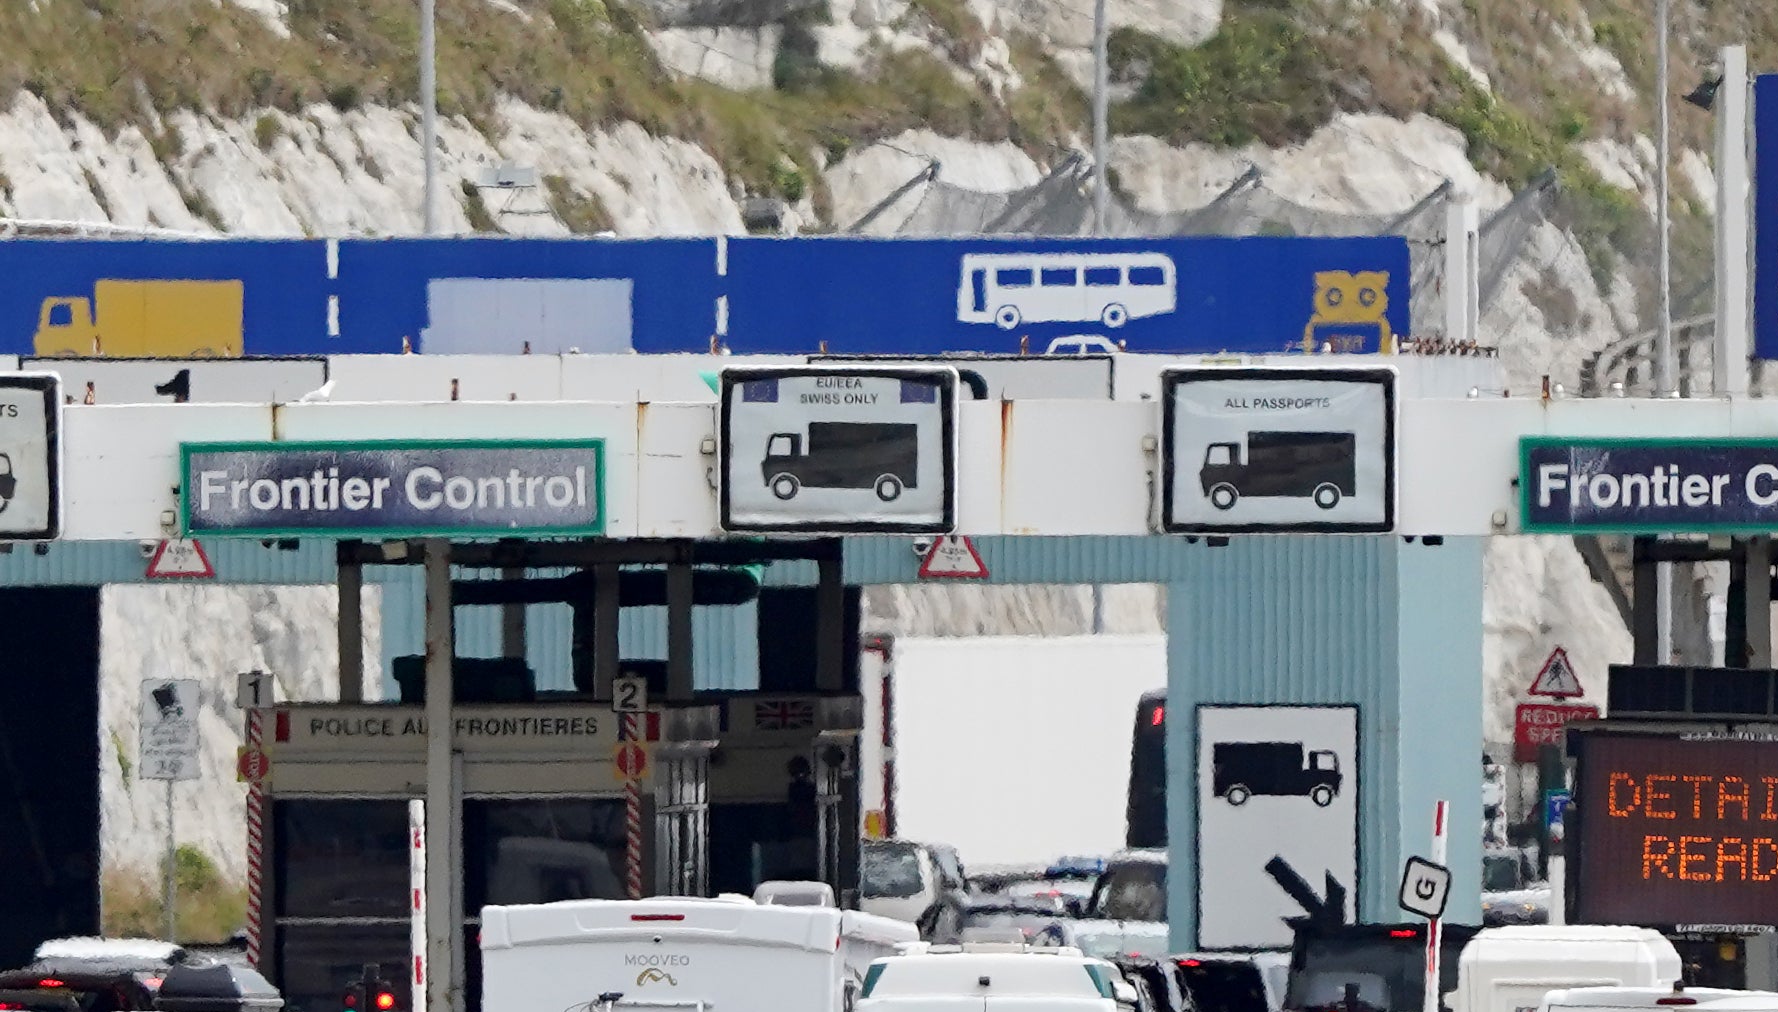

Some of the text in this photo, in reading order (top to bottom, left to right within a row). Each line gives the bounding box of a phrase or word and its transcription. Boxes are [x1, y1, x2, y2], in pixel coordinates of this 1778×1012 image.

[816, 377, 863, 389] EU/EEA
[800, 393, 879, 405] SWISS ONLY
[1224, 397, 1331, 409] ALL PASSPORTS
[198, 465, 587, 512] Frontier Control
[1537, 463, 1730, 508] Frontier
[248, 679, 260, 704] 1
[620, 683, 638, 708] 2
[310, 717, 598, 737] POLICE AU FRONTIERES
[1415, 877, 1437, 900] G
[624, 954, 690, 967] MOOVEO
